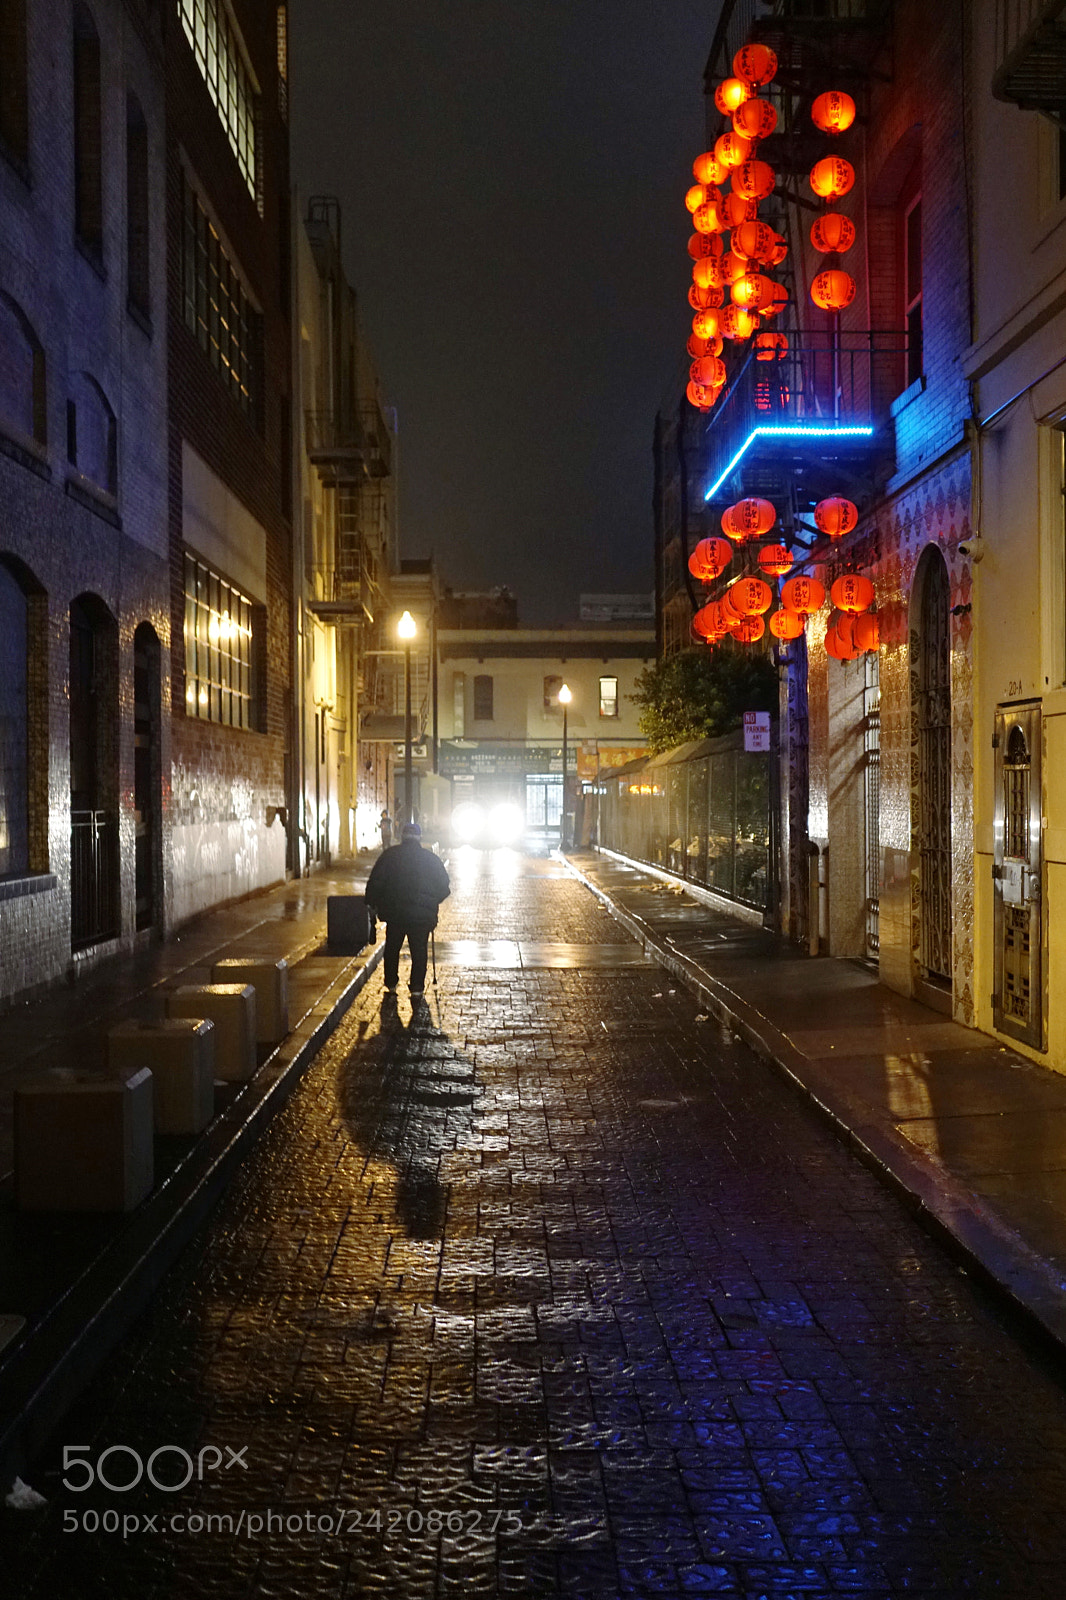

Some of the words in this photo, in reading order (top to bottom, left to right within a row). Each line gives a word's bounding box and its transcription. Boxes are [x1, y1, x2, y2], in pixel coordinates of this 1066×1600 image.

[1008, 680, 1023, 697] 20-A
[745, 713, 755, 722] NO
[746, 725, 768, 733] PARKING
